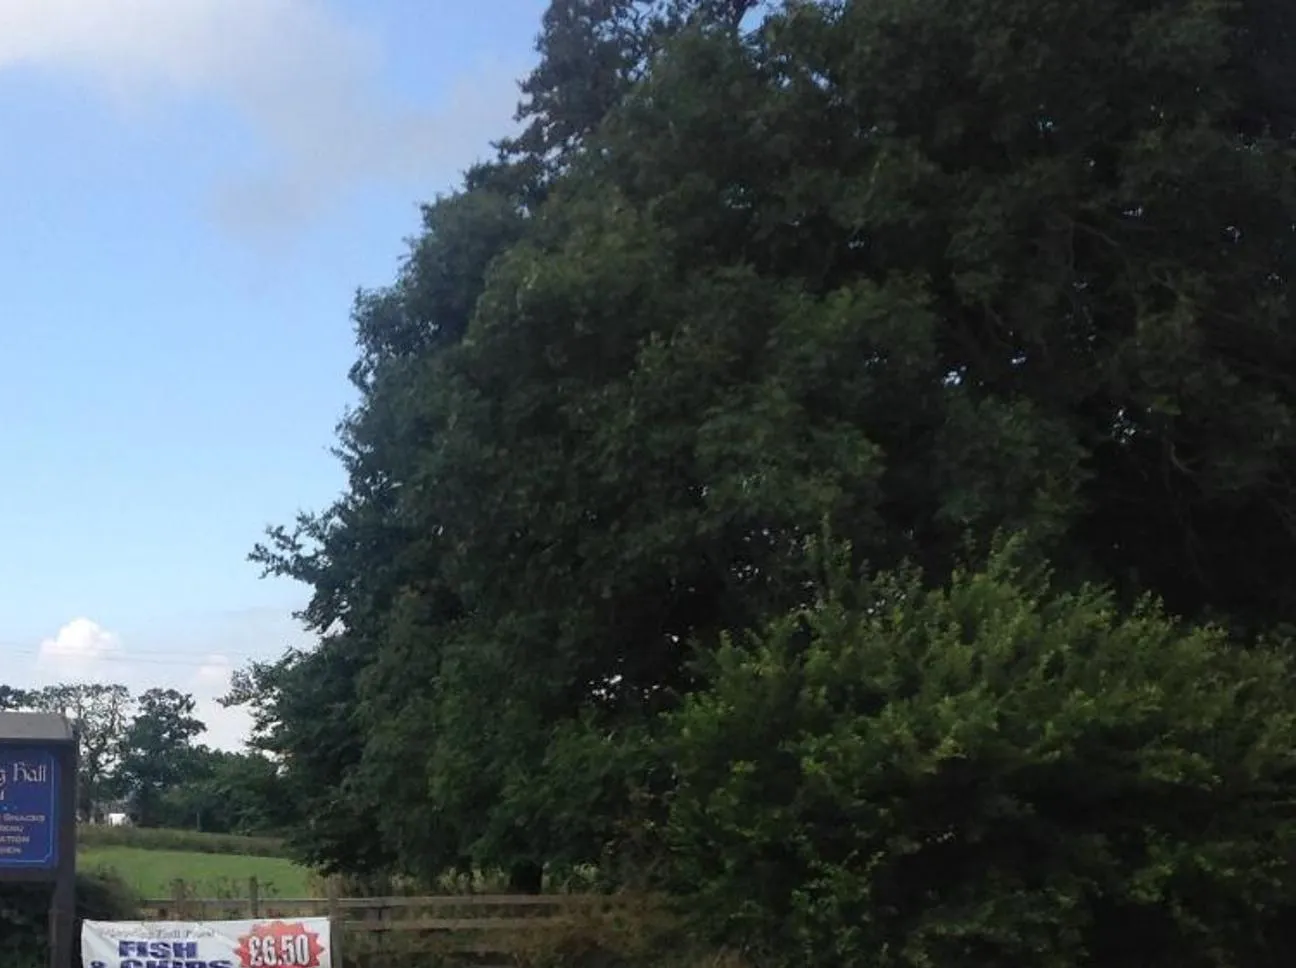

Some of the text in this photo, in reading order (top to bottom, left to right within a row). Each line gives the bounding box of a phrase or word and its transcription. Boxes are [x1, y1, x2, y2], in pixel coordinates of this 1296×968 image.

[13, 761, 46, 782] Hall
[118, 940, 198, 959] FISH
[249, 934, 310, 967] £6.50
